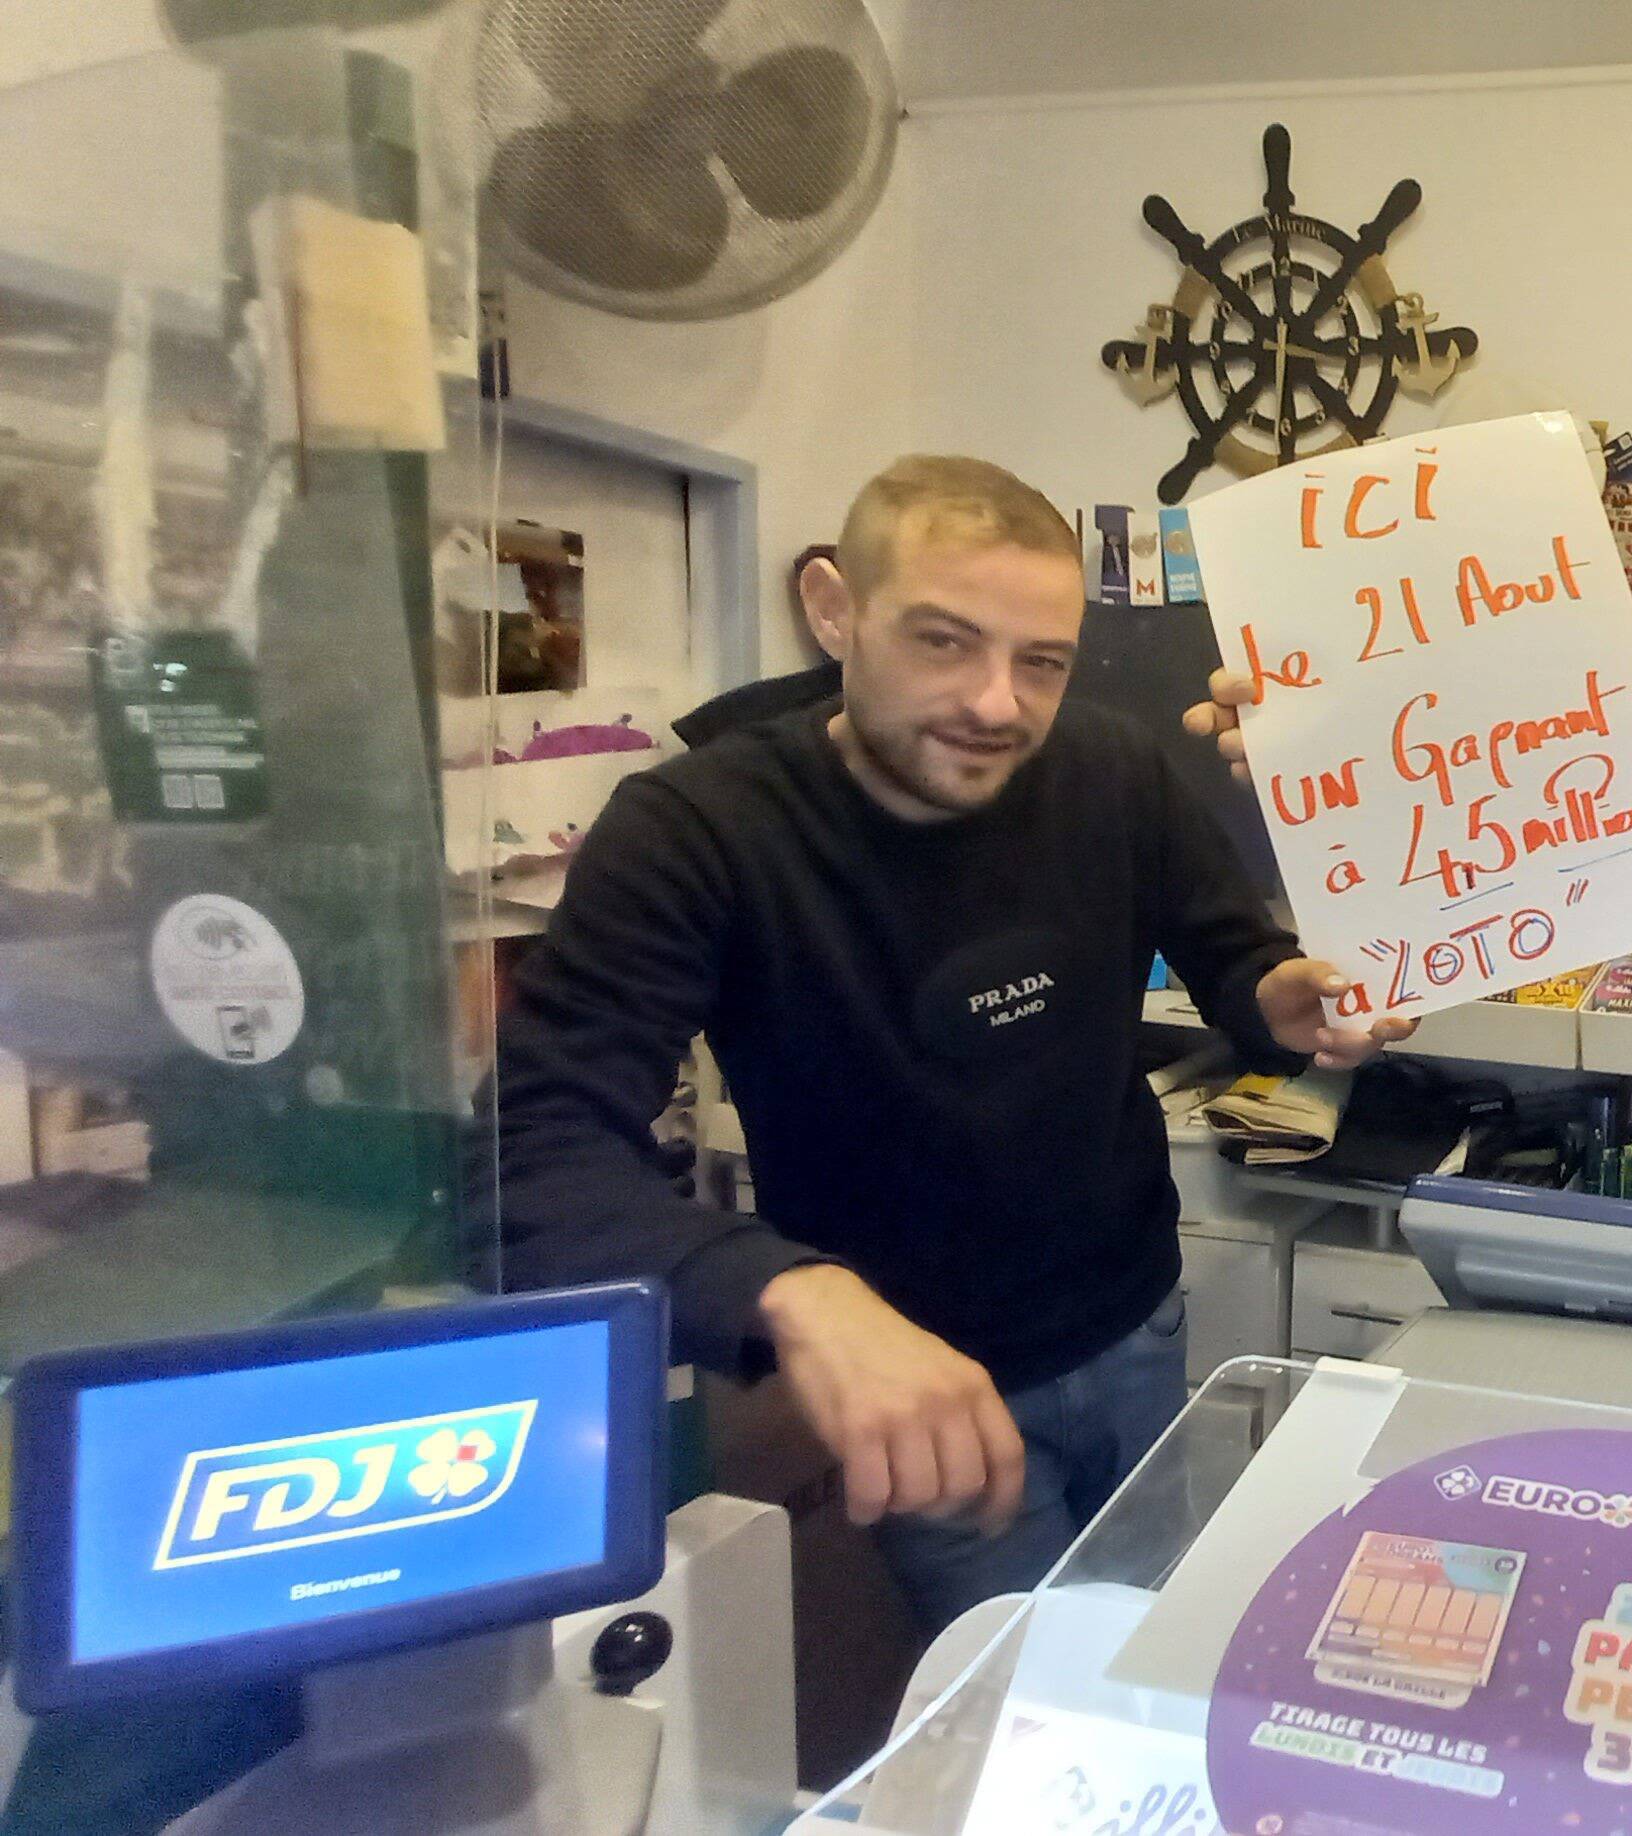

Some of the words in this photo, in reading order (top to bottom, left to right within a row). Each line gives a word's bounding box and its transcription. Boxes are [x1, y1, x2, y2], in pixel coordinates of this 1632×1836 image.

[1136, 579, 1155, 596] M
[1354, 578, 1430, 662] 21
[1392, 671, 1626, 806] Gagnant
[1326, 843, 1366, 894] à
[968, 972, 1056, 1014] PRADA
[989, 999, 1046, 1027] MILANO
[189, 1443, 397, 1542] FDJ
[1487, 1479, 1601, 1517] EURO
[289, 1567, 402, 1601] Bienvenue
[1269, 1700, 1366, 1738] TIRAGE
[1369, 1720, 1435, 1753] TOUS
[1437, 1736, 1488, 1765] LES
